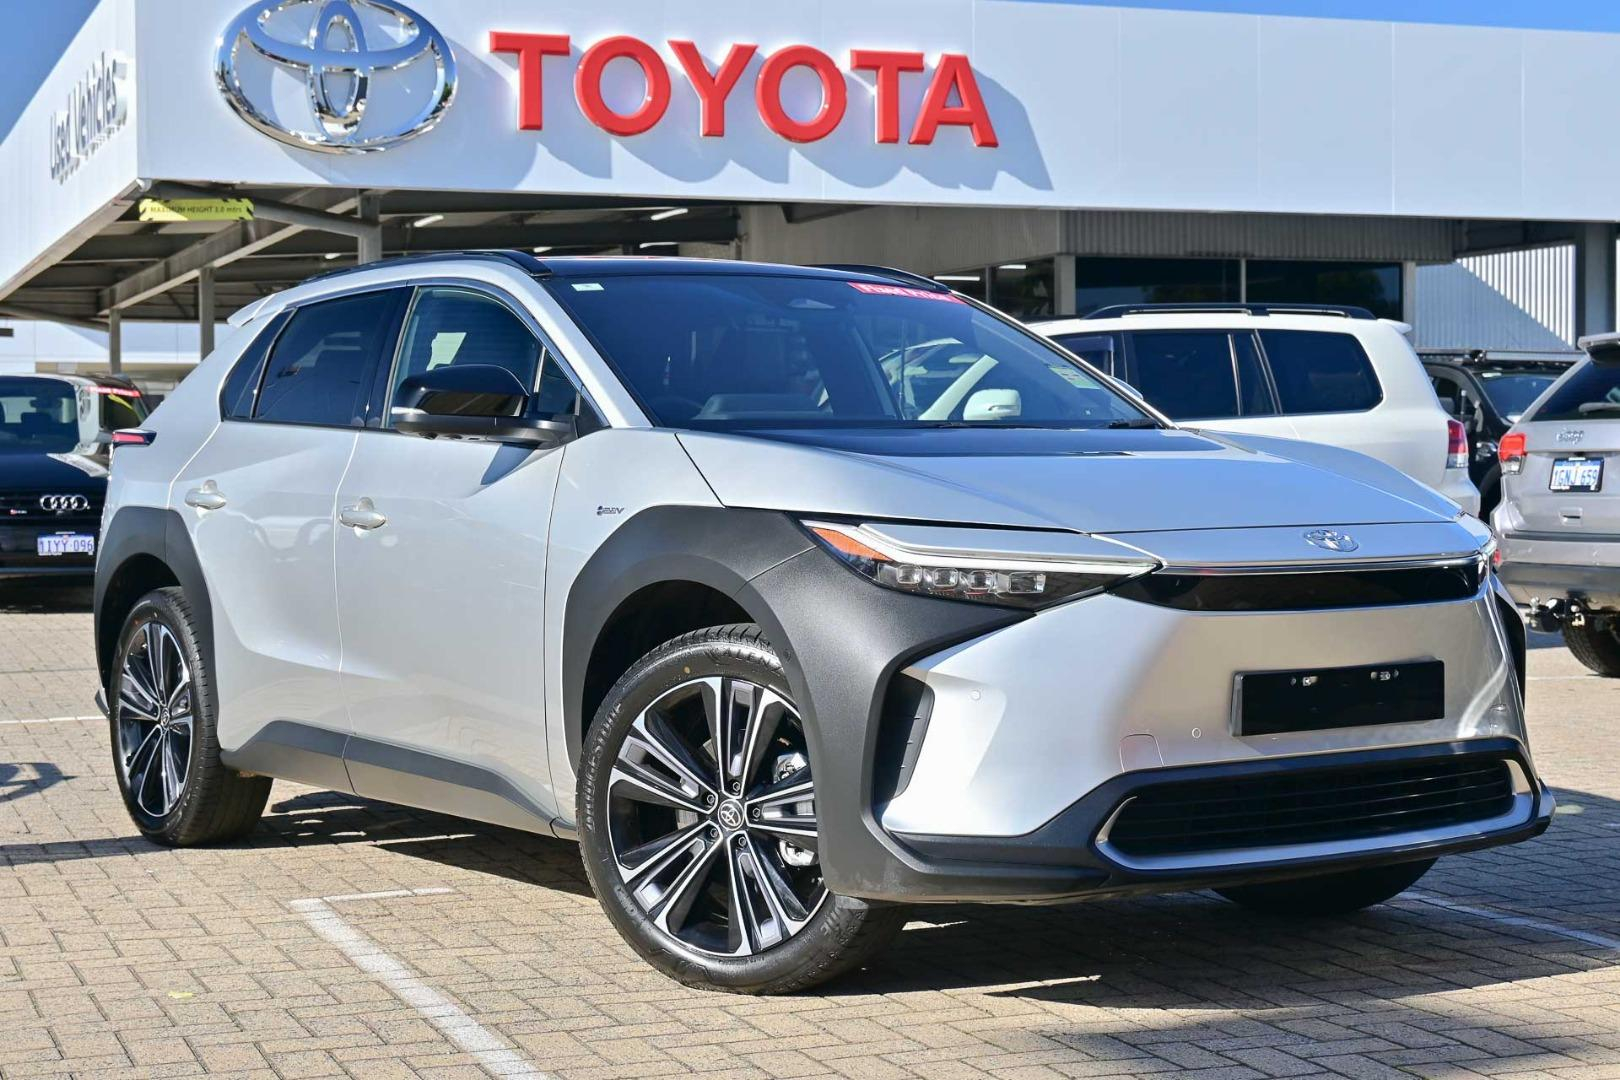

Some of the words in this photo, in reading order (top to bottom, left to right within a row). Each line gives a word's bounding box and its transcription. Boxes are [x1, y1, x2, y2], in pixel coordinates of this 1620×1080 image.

[50, 93, 71, 181] Used
[73, 51, 117, 156] Vehicles
[489, 30, 999, 148] TOYOTA
[187, 205, 213, 214] HEIGHT
